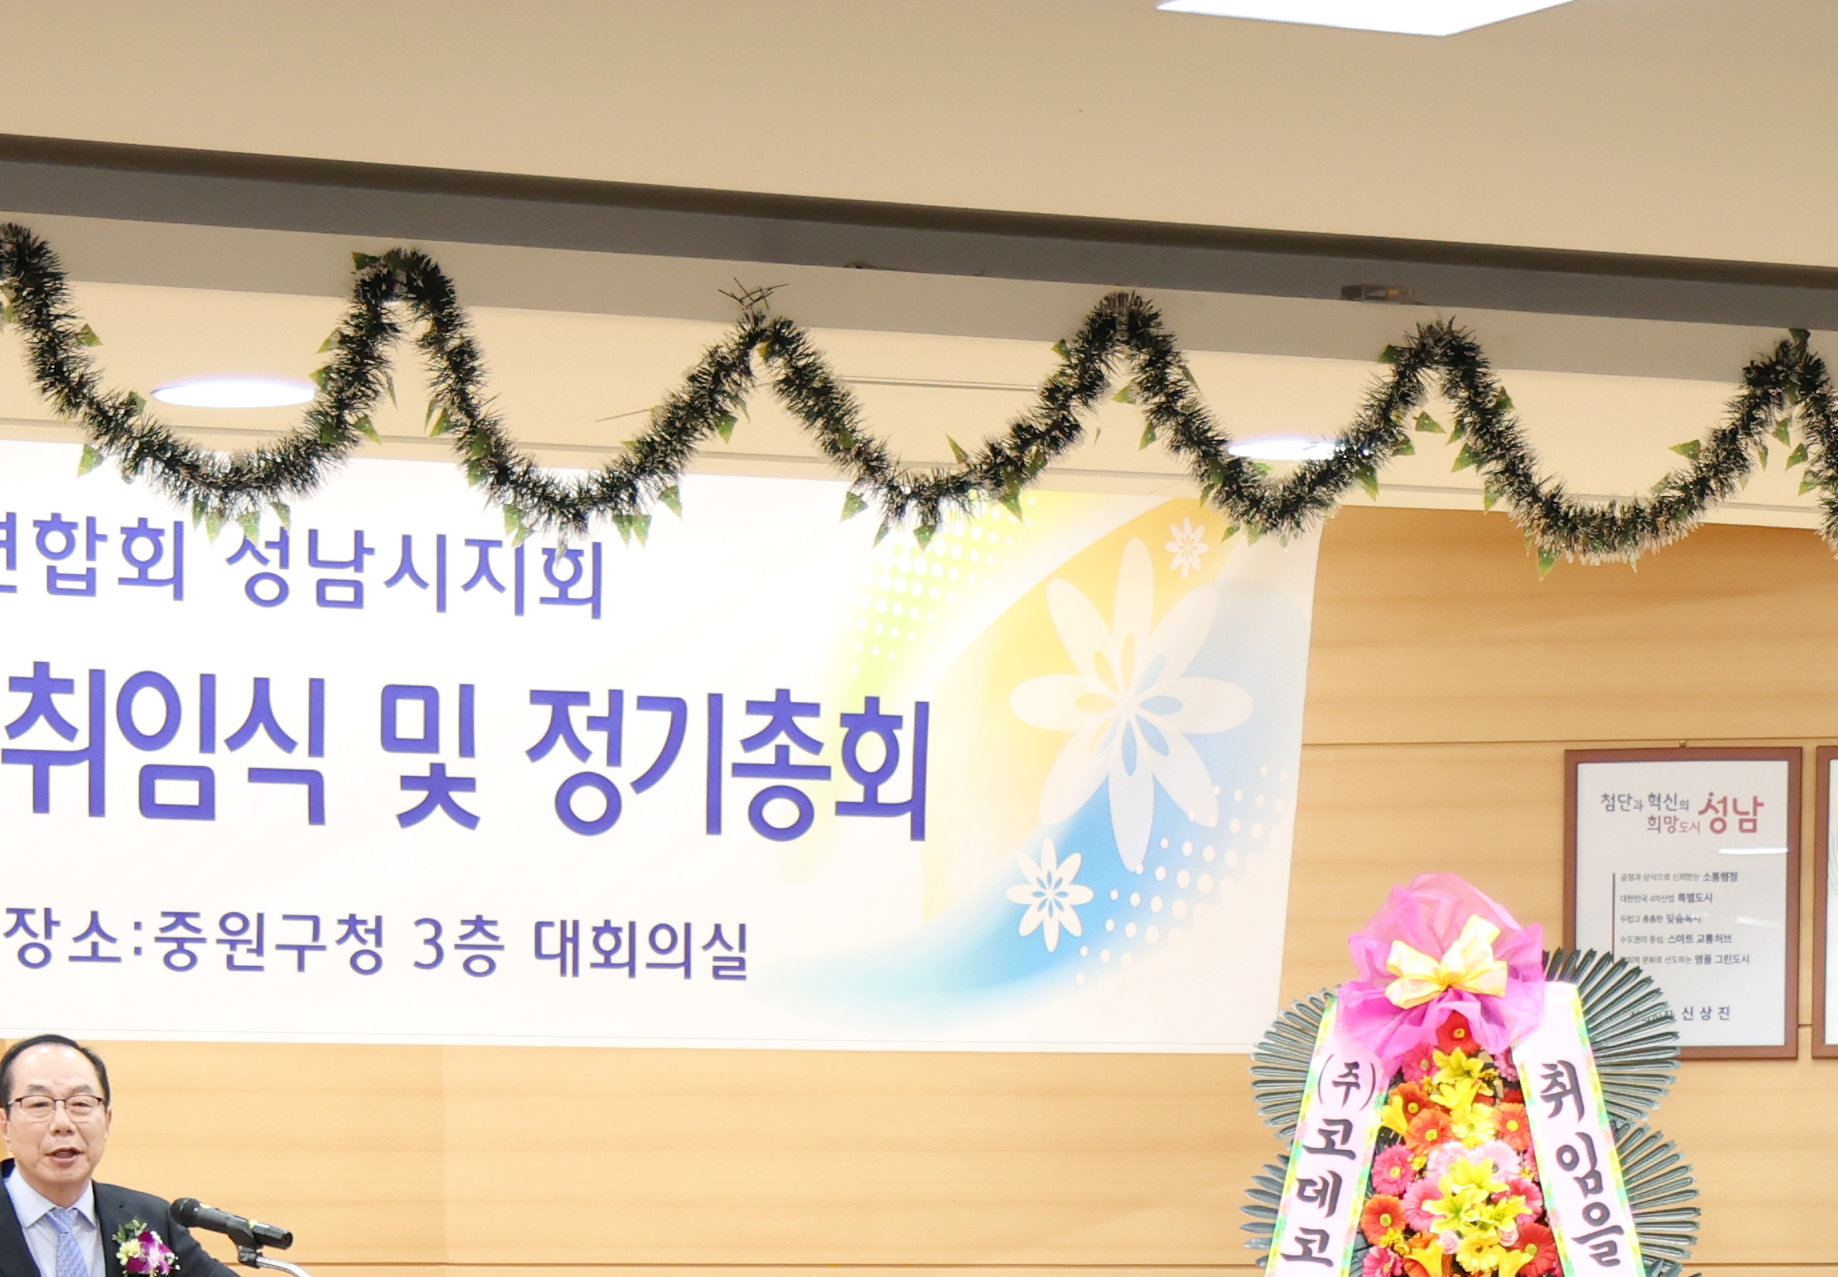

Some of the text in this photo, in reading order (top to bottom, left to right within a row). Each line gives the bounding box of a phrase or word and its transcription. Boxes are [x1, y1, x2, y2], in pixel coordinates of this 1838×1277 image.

[225, 525, 602, 620] 성남시지회
[0, 660, 327, 826] 취임식
[380, 682, 481, 831] 및
[525, 687, 931, 842] 정기총회
[1600, 791, 1690, 813] 첨단과 혁신의
[1647, 814, 1701, 835] 희망도시
[1698, 791, 1764, 835] 성남
[1677, 892, 1714, 904] 특별도시
[2, 905, 749, 981] 장소:중원구청 3층 대회의실
[1666, 934, 1694, 945] 스마트
[1695, 934, 1733, 945] 교통허브
[1279, 1056, 1378, 1270] (주)코데코
[1538, 1058, 1626, 1268] 취임을
